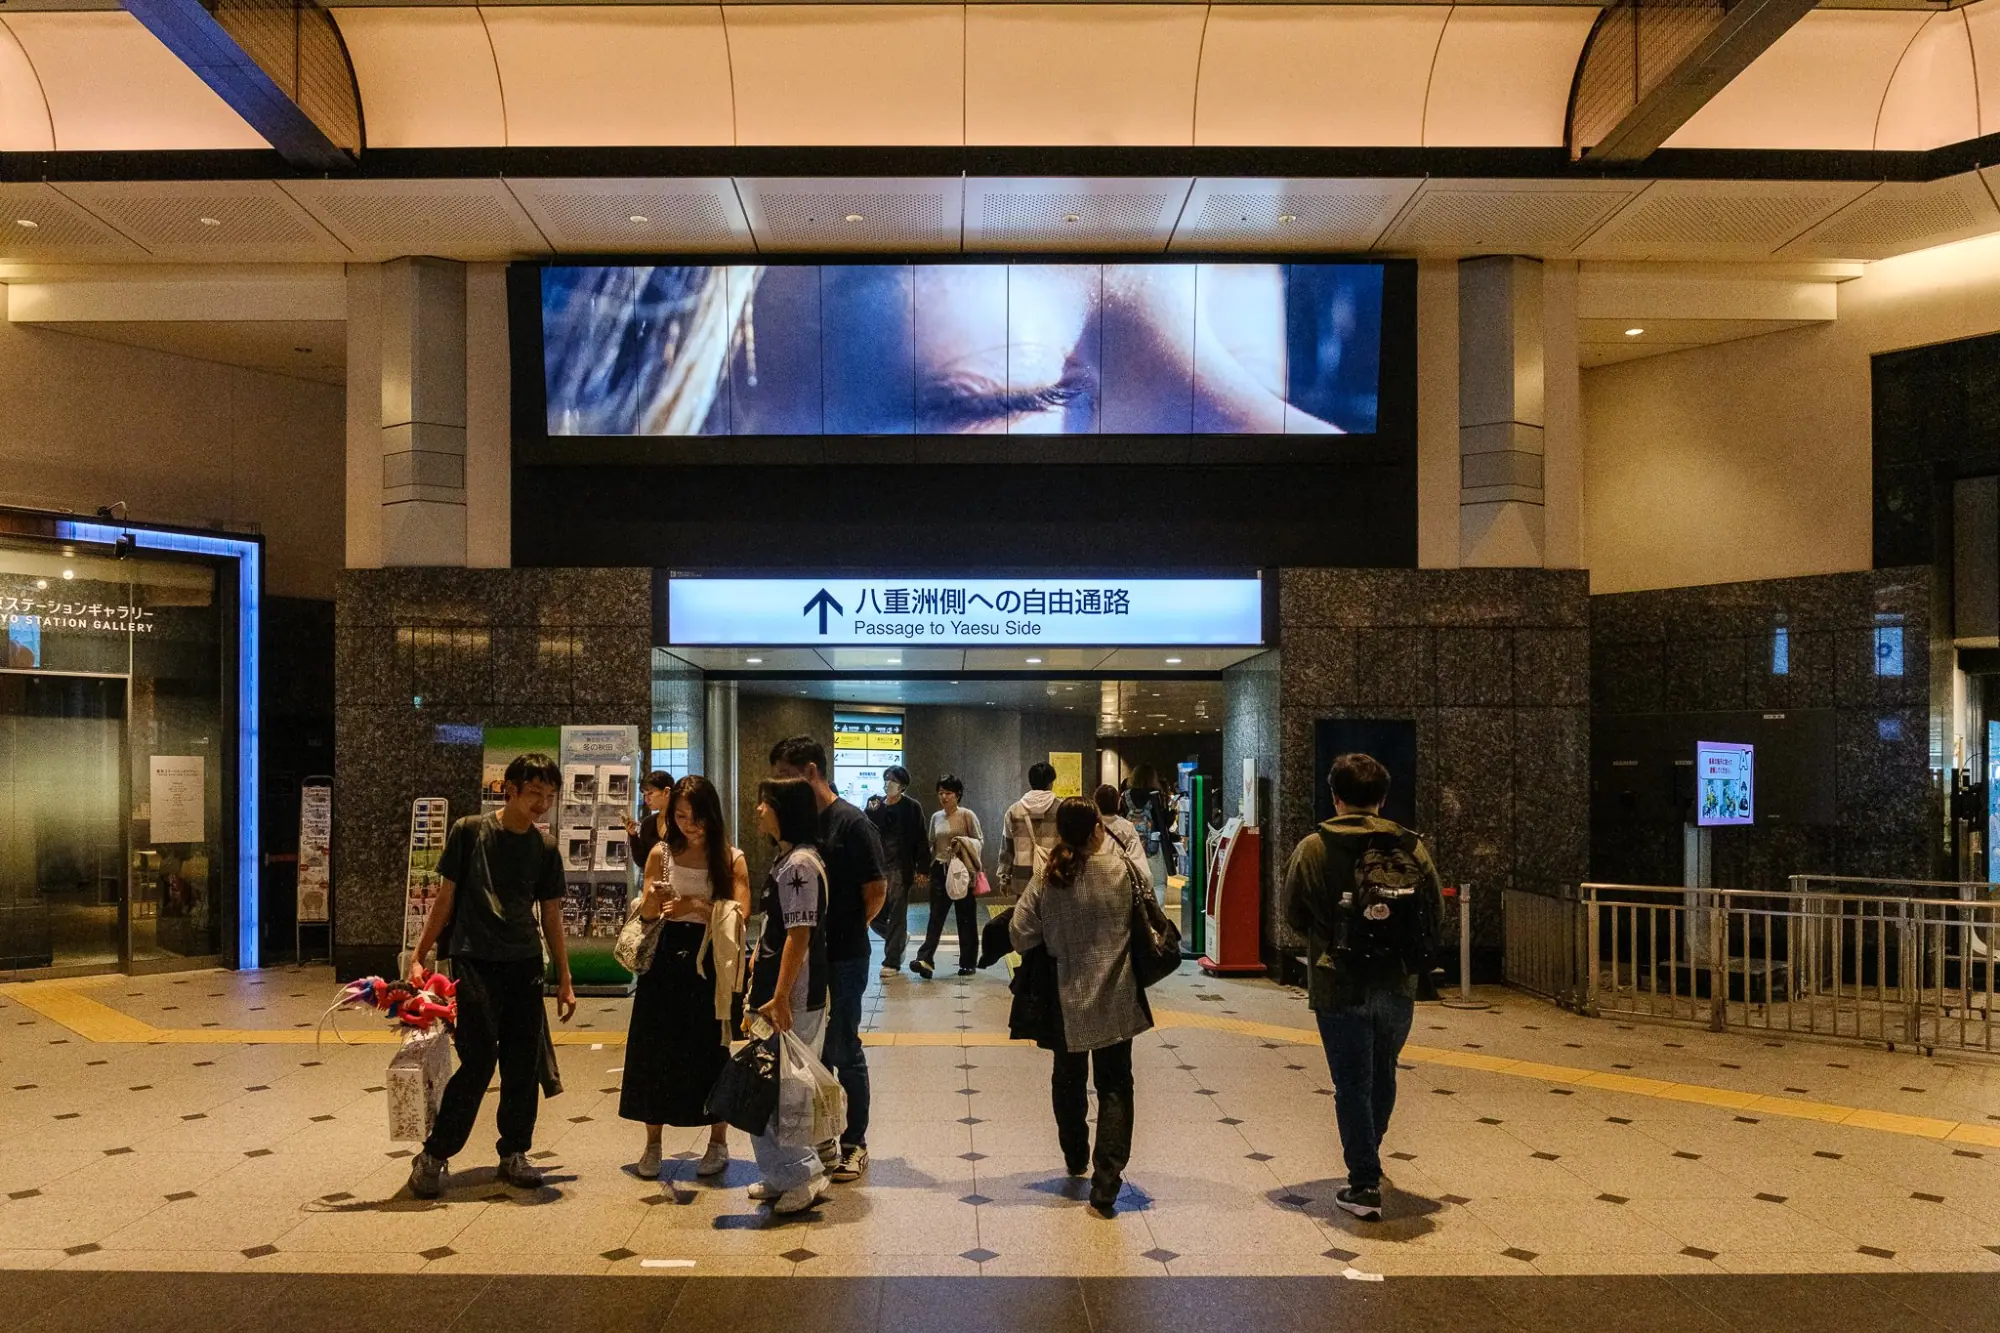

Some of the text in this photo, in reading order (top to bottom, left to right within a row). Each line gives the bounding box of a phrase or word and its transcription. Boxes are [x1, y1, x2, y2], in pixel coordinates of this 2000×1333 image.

[0, 596, 154, 620] ステーションギャラリー
[855, 588, 1130, 615] 八重洲側への自由通路
[25, 615, 87, 628] STATION
[93, 621, 153, 633] GALLERY
[854, 620, 1041, 639] Passage to Yaesu Side
